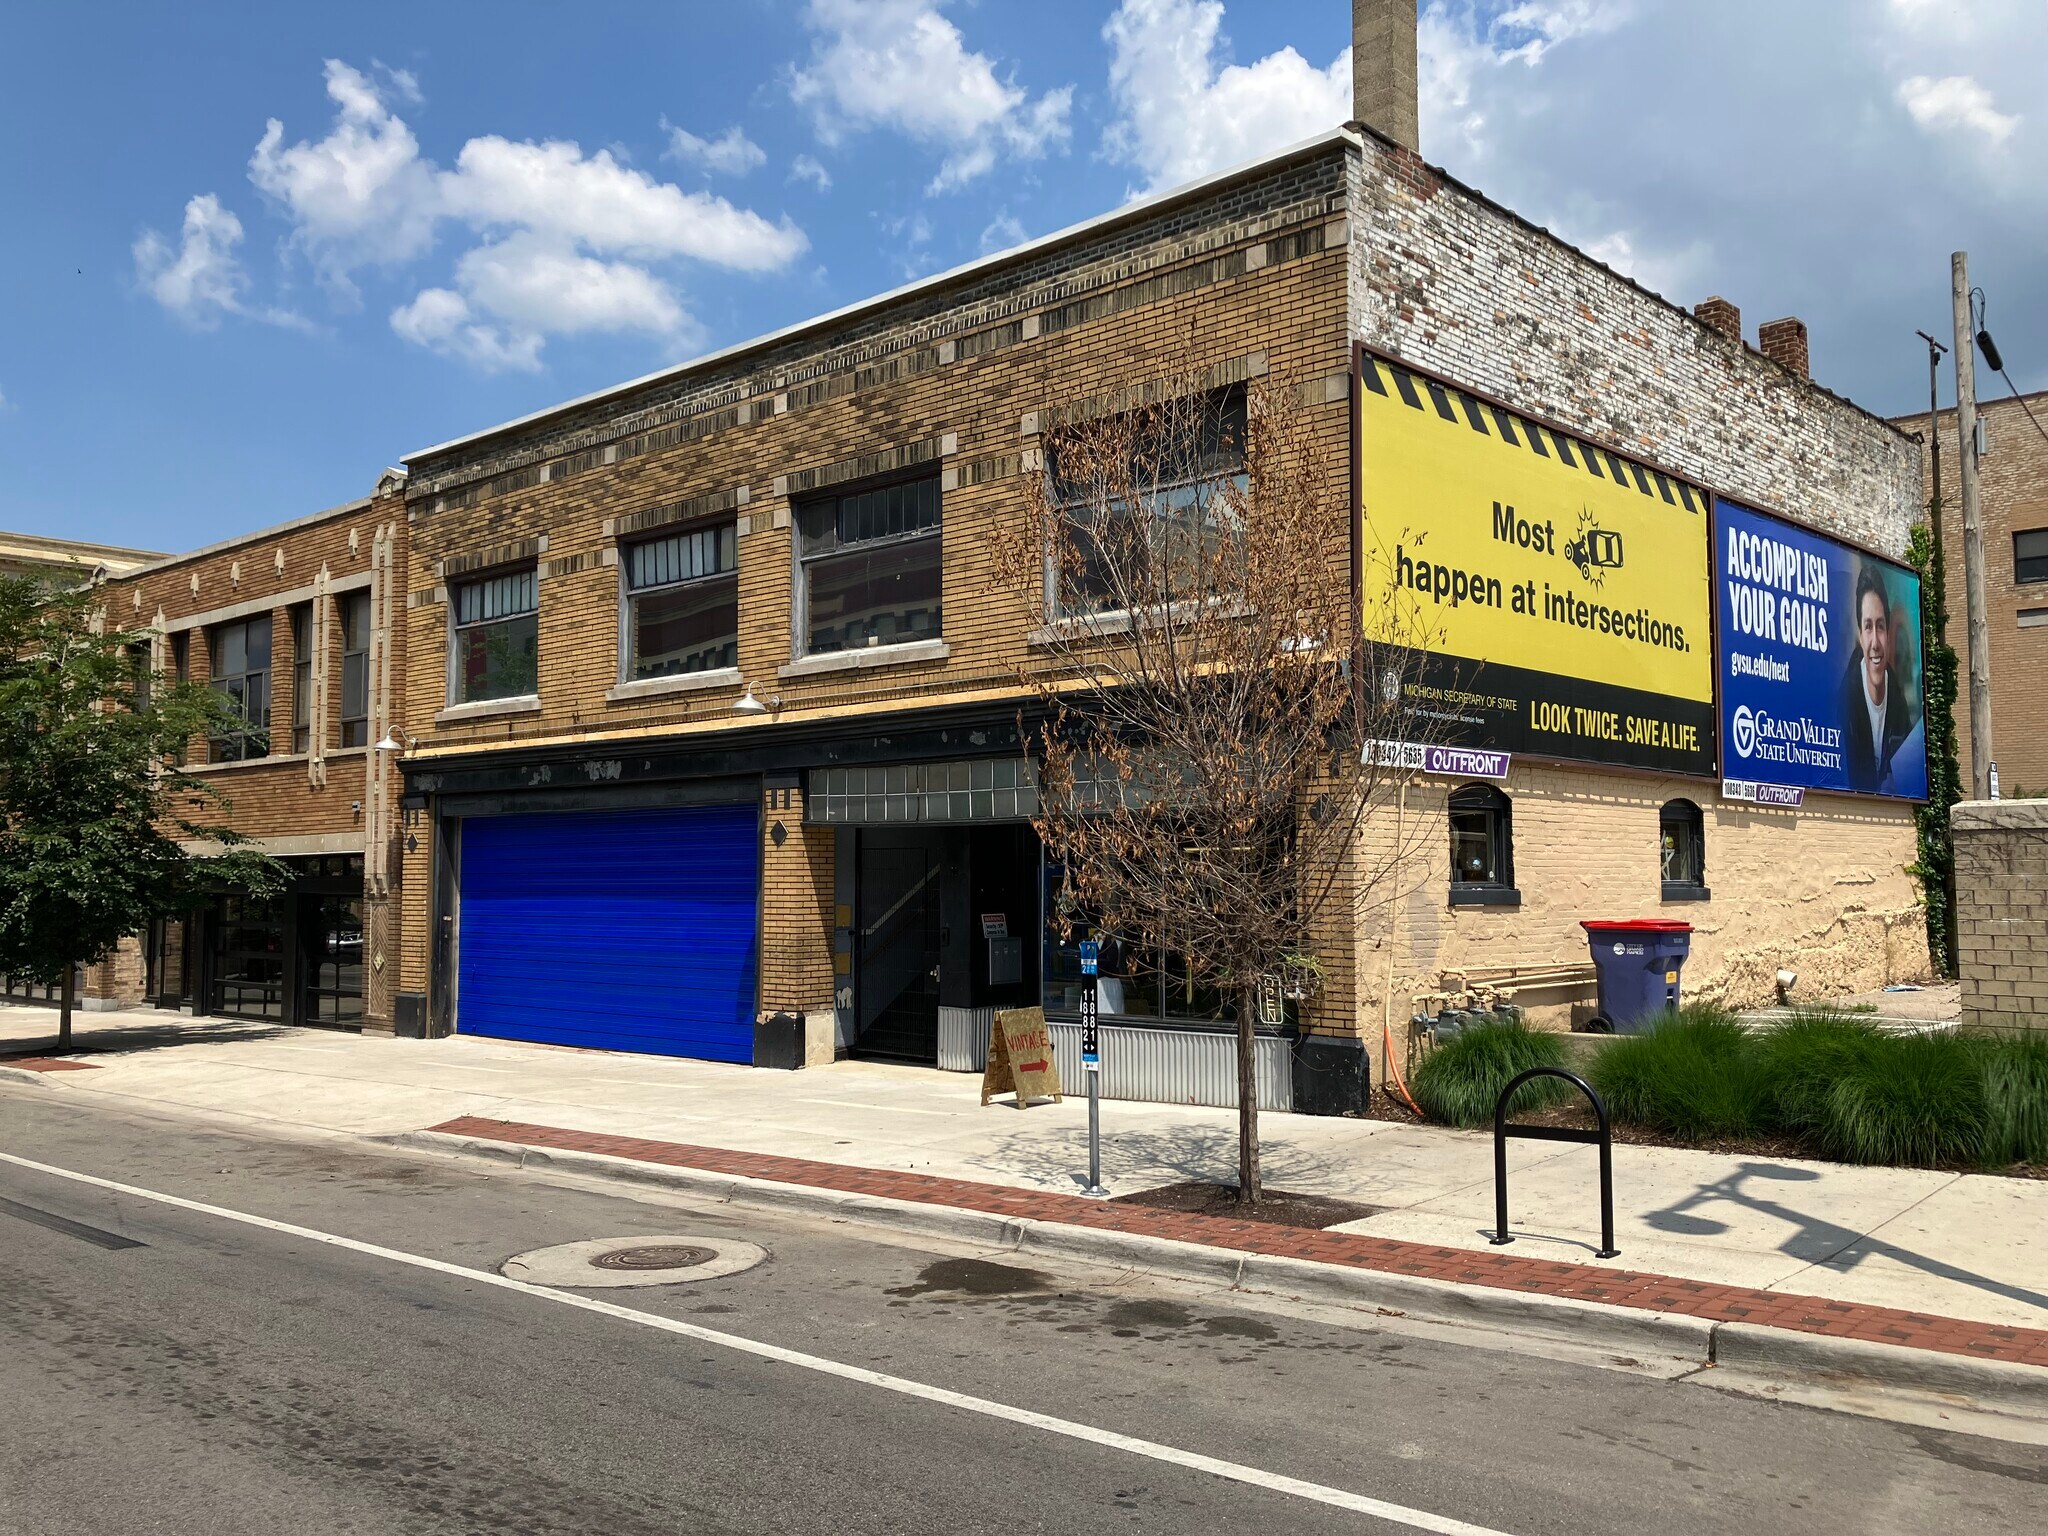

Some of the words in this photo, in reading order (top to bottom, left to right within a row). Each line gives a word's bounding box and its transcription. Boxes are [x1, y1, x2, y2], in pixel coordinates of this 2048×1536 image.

[1492, 501, 1555, 556] Most
[1728, 526, 1829, 603] ACCOMPLISH
[1396, 544, 1502, 608] happen
[1511, 579, 1536, 616] at
[1544, 582, 1690, 652] intersections.
[1728, 580, 1777, 641] YOUR
[1780, 596, 1828, 653] GOALS
[1731, 651, 1790, 683] gvsu.edu/next
[1404, 683, 1443, 700] MICHIGAN
[1443, 689, 1486, 705] SECRETARY
[1486, 696, 1497, 708] OF
[1497, 697, 1518, 711] STATE
[1531, 700, 1571, 734] LOOK
[1574, 707, 1623, 741] TWICE.
[1626, 715, 1660, 746] SAVE
[1661, 721, 1671, 748] A
[1672, 723, 1700, 751] LIFE.
[1755, 710, 1801, 741] GRAND
[1800, 717, 1841, 748] VALLEY
[1403, 746, 1422, 764] 5635
[1432, 750, 1502, 775] OUTFRONT
[1755, 737, 1785, 762] STATE
[1786, 742, 1841, 768] UNIVERSITY
[1759, 786, 1800, 803] OUTFRONT
[1007, 1031, 1048, 1051] VINTAGE
